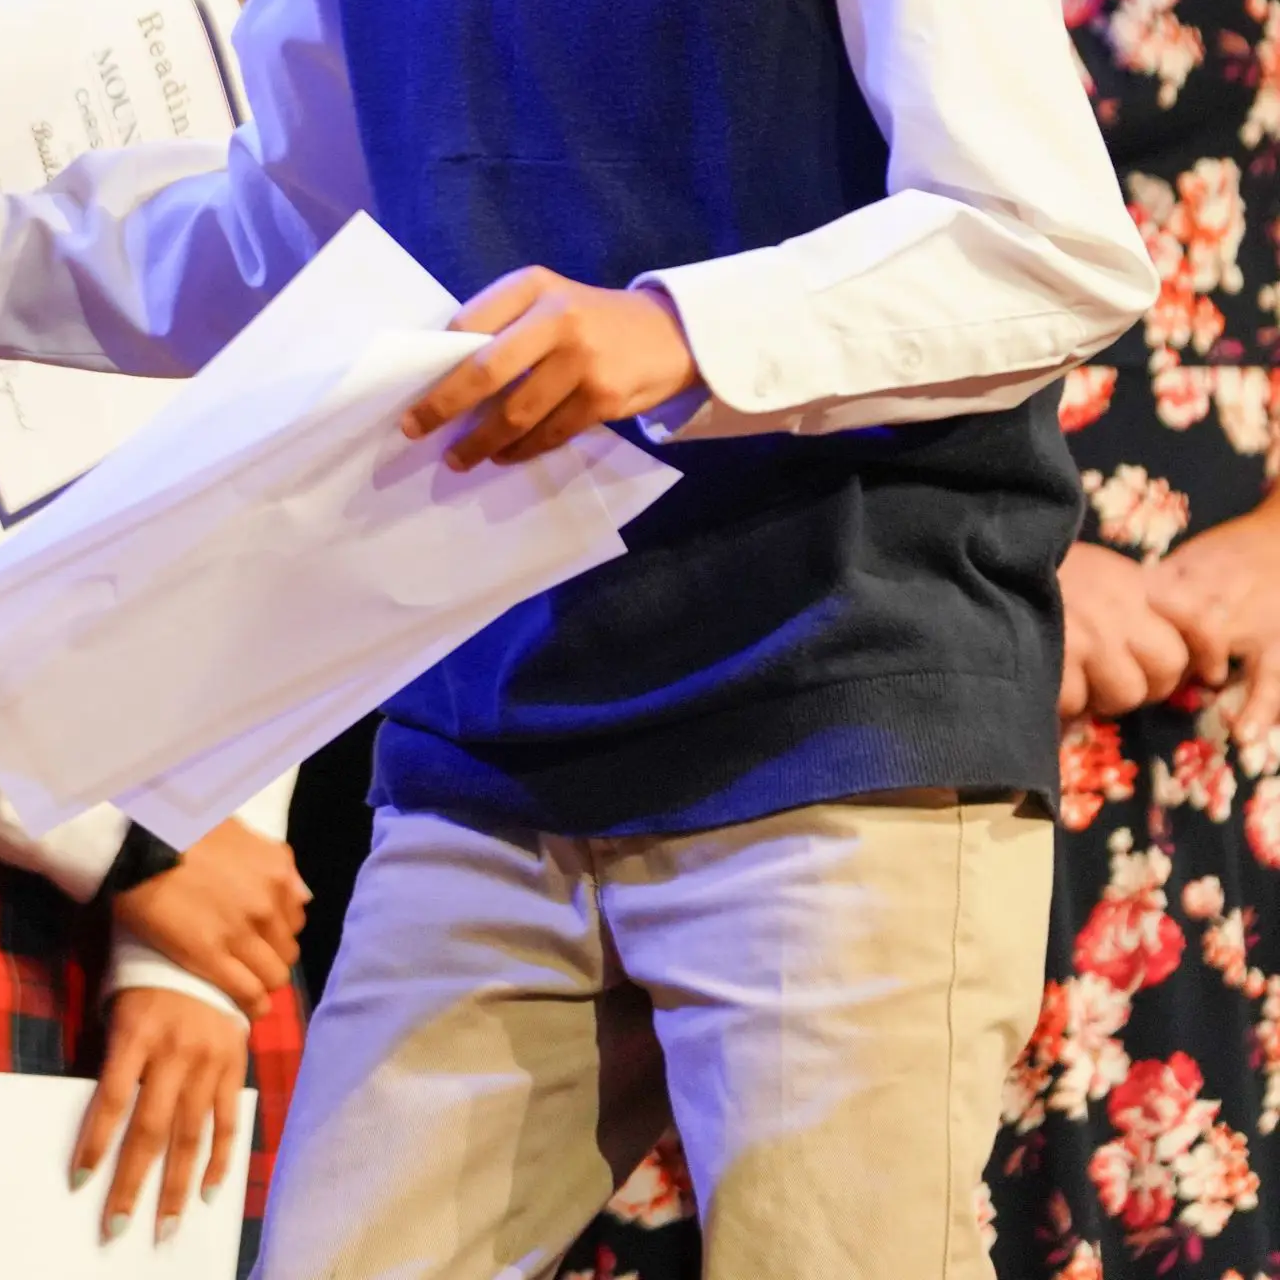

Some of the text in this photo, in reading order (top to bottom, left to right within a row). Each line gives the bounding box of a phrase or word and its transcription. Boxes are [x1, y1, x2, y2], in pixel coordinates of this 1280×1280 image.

[75, 88, 104, 150] CHRIS
[94, 47, 143, 146] MOUN
[138, 11, 195, 138] Readin
